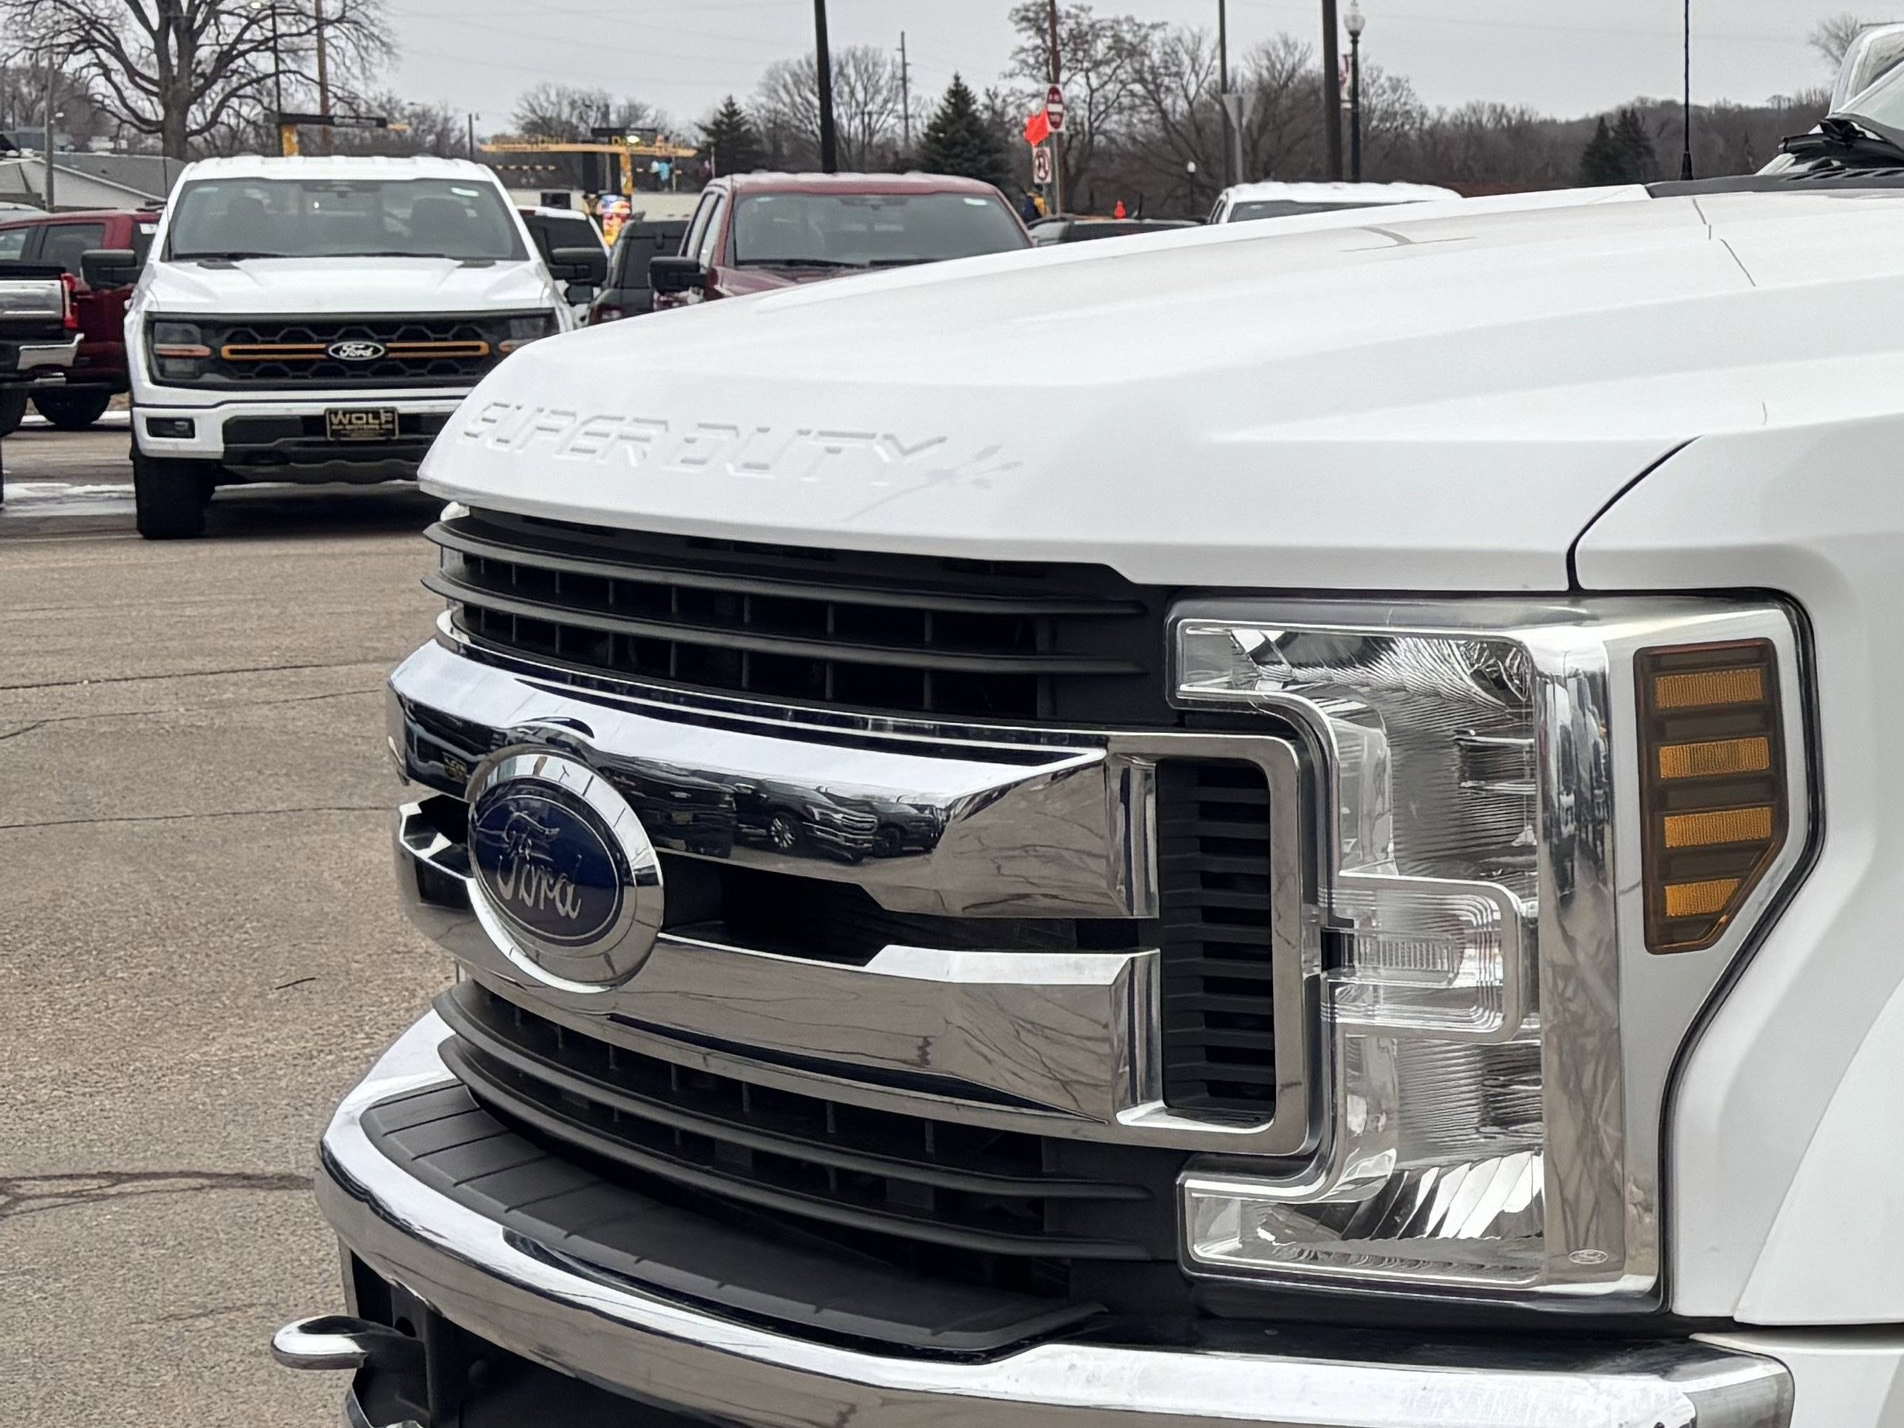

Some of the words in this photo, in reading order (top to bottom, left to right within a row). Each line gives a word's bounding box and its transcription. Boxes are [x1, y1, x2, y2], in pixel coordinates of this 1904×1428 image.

[339, 343, 374, 357] Ford
[331, 413, 392, 424] WOLF
[462, 401, 670, 467] SUPER
[660, 420, 949, 487] DUTY
[496, 809, 584, 920] Ford
